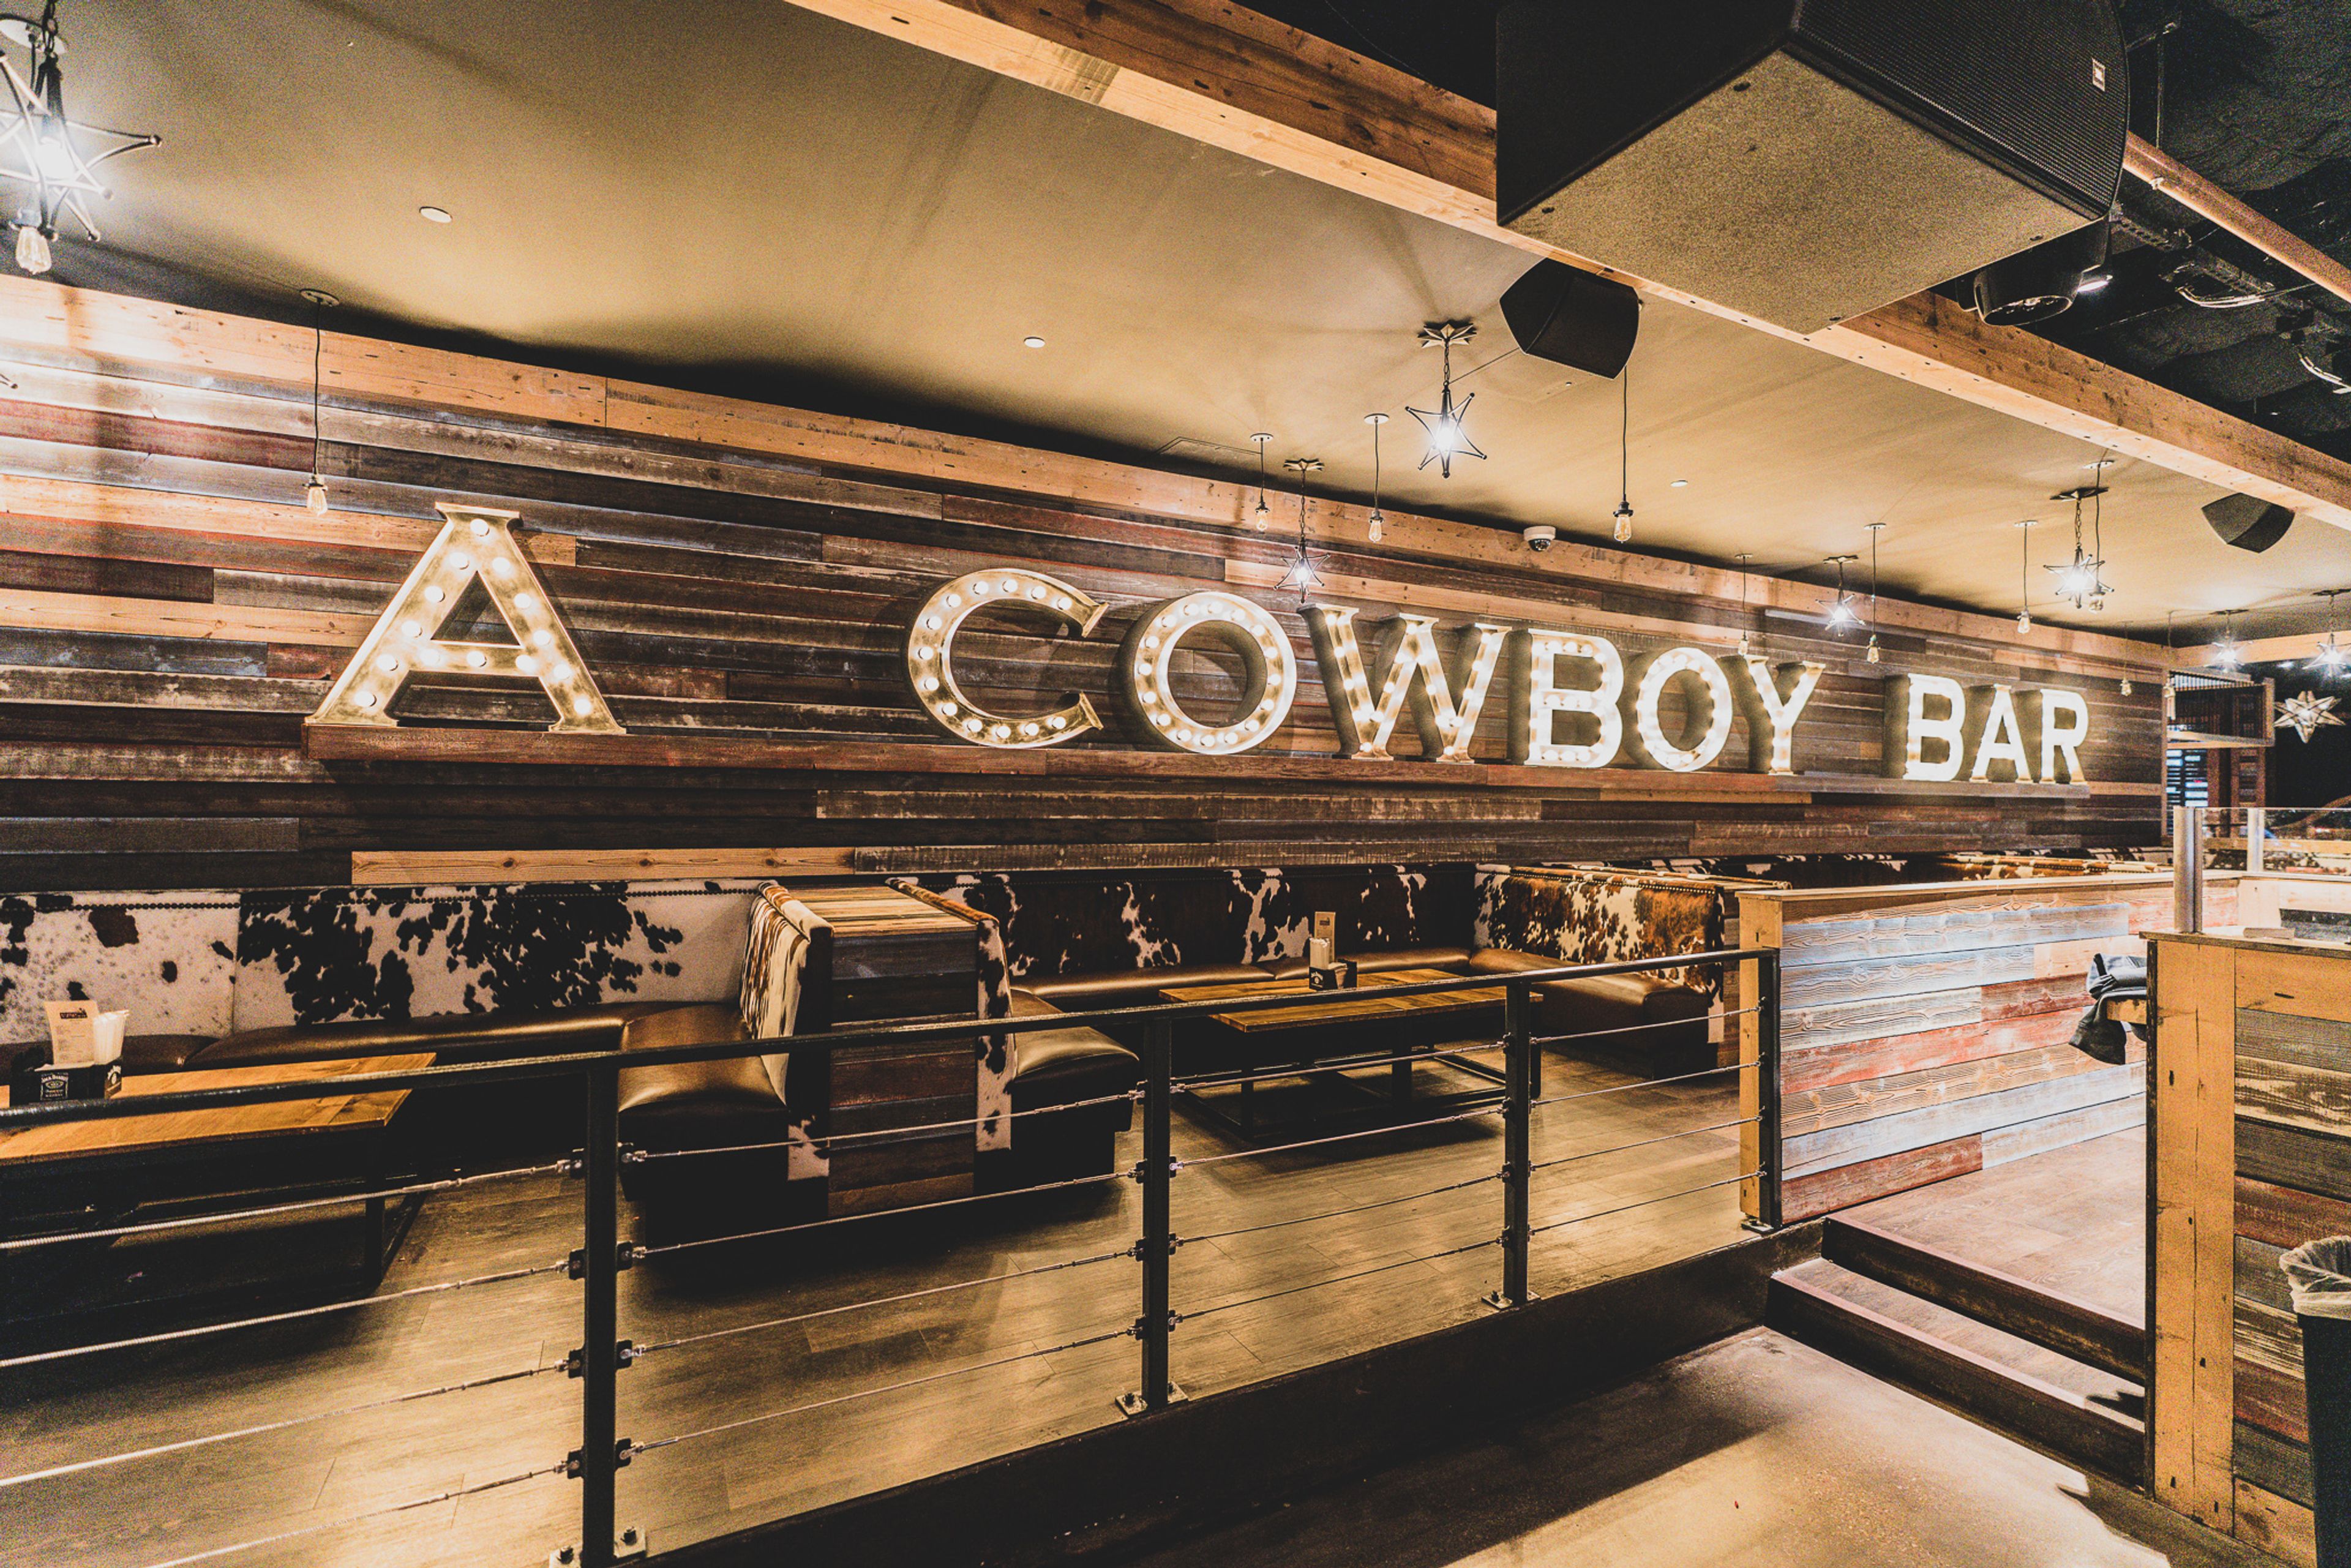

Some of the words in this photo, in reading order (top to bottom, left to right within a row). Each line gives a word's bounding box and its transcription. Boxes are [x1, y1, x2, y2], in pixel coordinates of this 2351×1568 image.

[305, 503, 626, 734] A
[906, 568, 1826, 775] COWBOY
[1903, 673, 2089, 784] BAR
